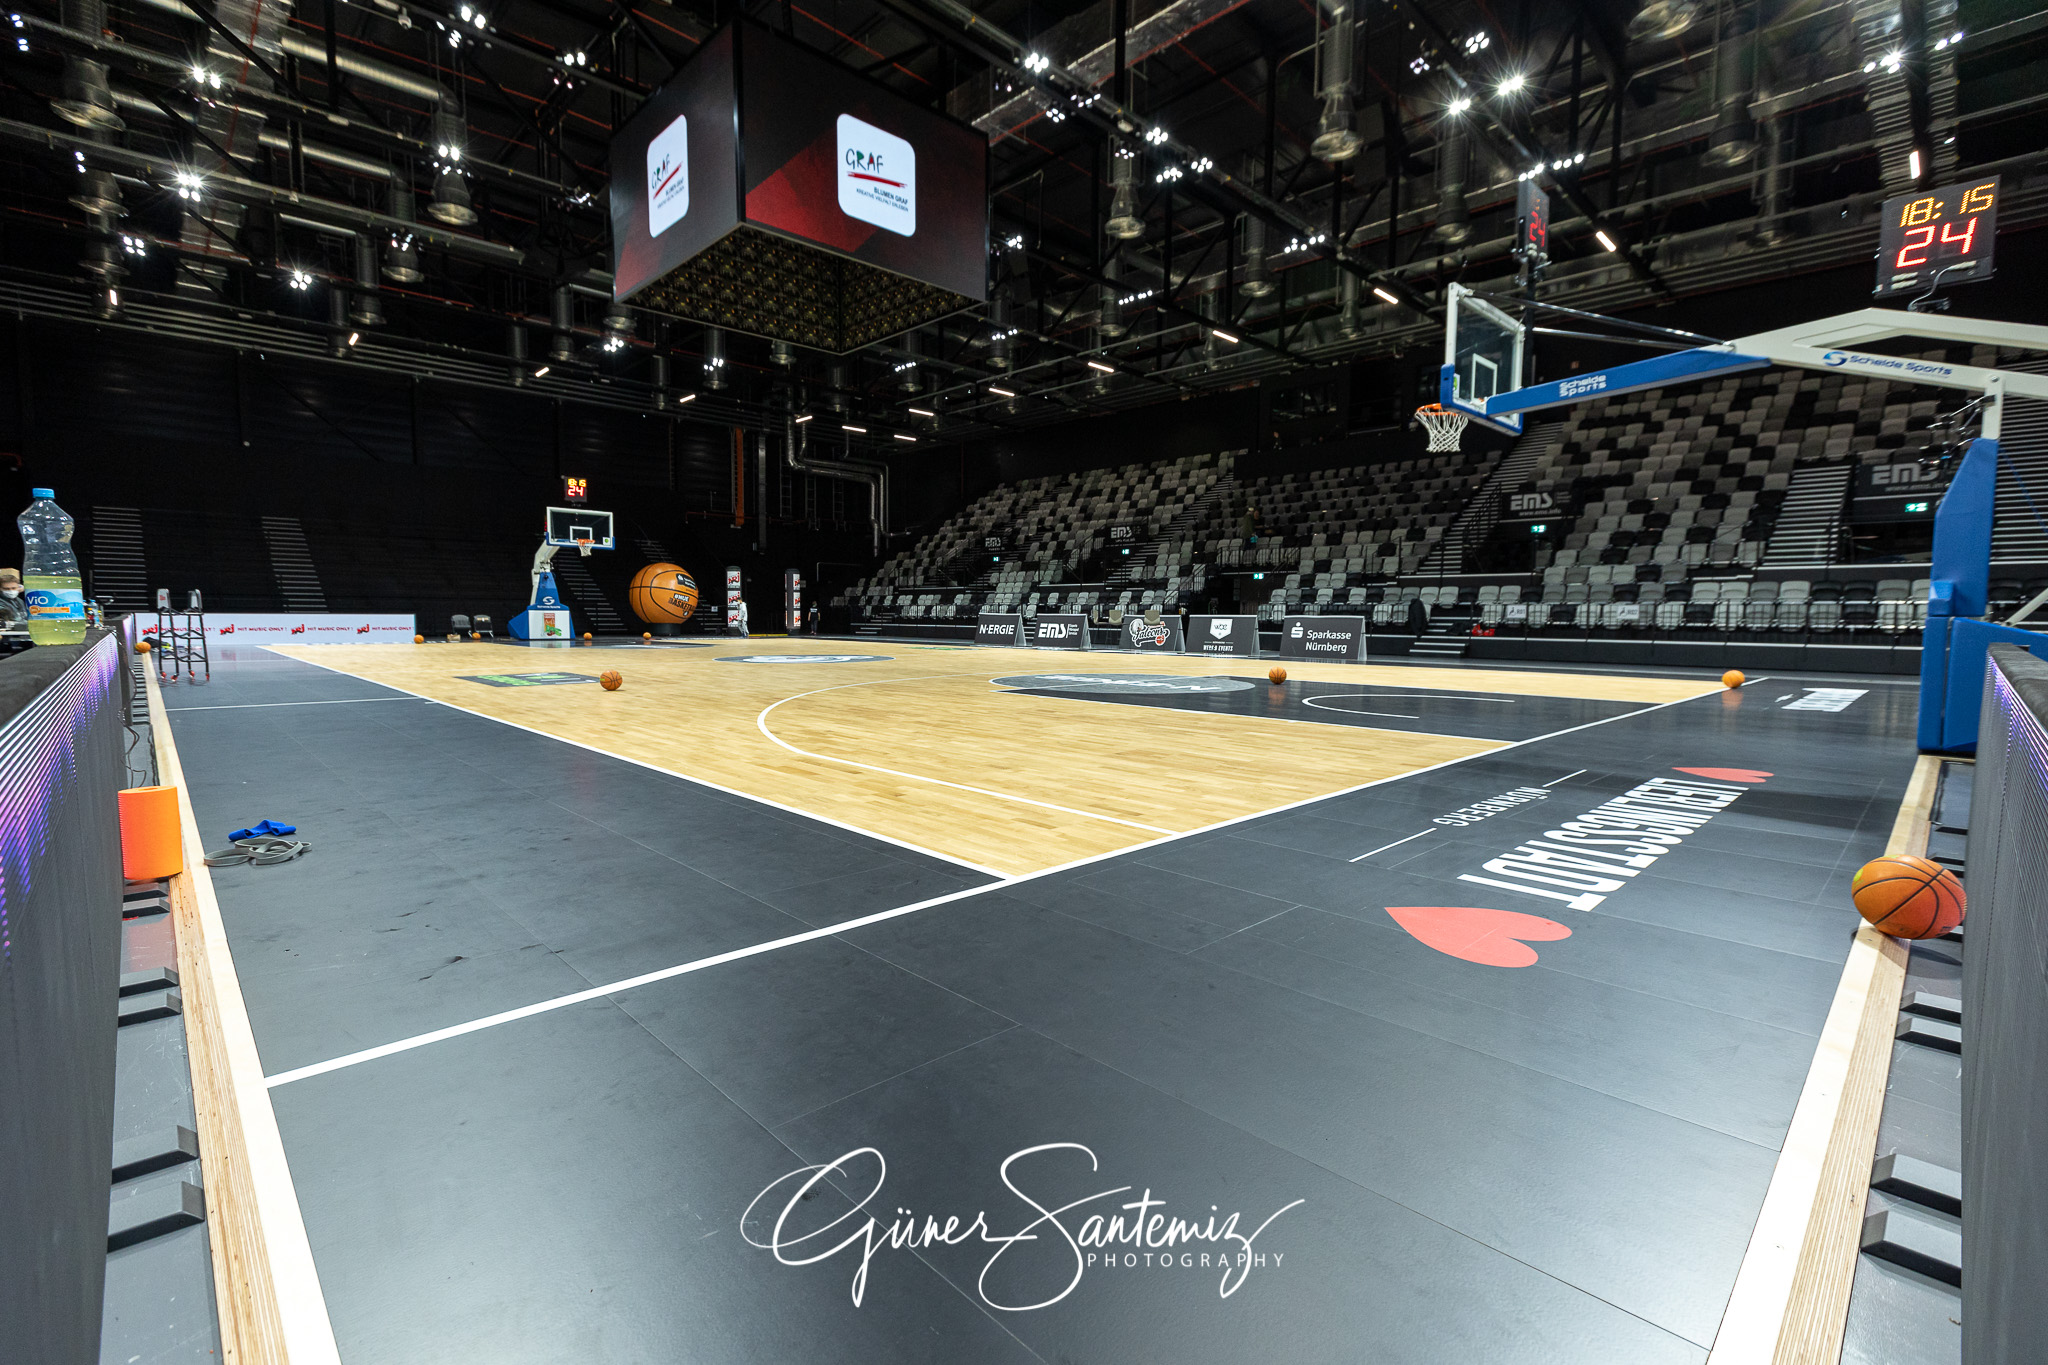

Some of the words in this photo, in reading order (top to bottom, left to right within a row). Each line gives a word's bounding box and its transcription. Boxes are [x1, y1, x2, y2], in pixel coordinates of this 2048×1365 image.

[846, 148, 884, 174] GRAF
[651, 153, 670, 190] GRAF
[873, 186, 895, 200] BLUMEN
[895, 195, 909, 205] GRAF
[1896, 217, 1978, 268] 24
[1905, 362, 1953, 375] Sports
[1559, 382, 1607, 397] Sports
[567, 485, 585, 497] 24
[1511, 492, 1553, 511] EMS
[1038, 623, 1067, 639] EMS
[1306, 630, 1352, 640] Sparkasse
[1305, 642, 1348, 654] Nürnberg
[1432, 786, 1552, 827] NÜRNBERG
[1457, 777, 1749, 913] LIEBLINGSSTADT
